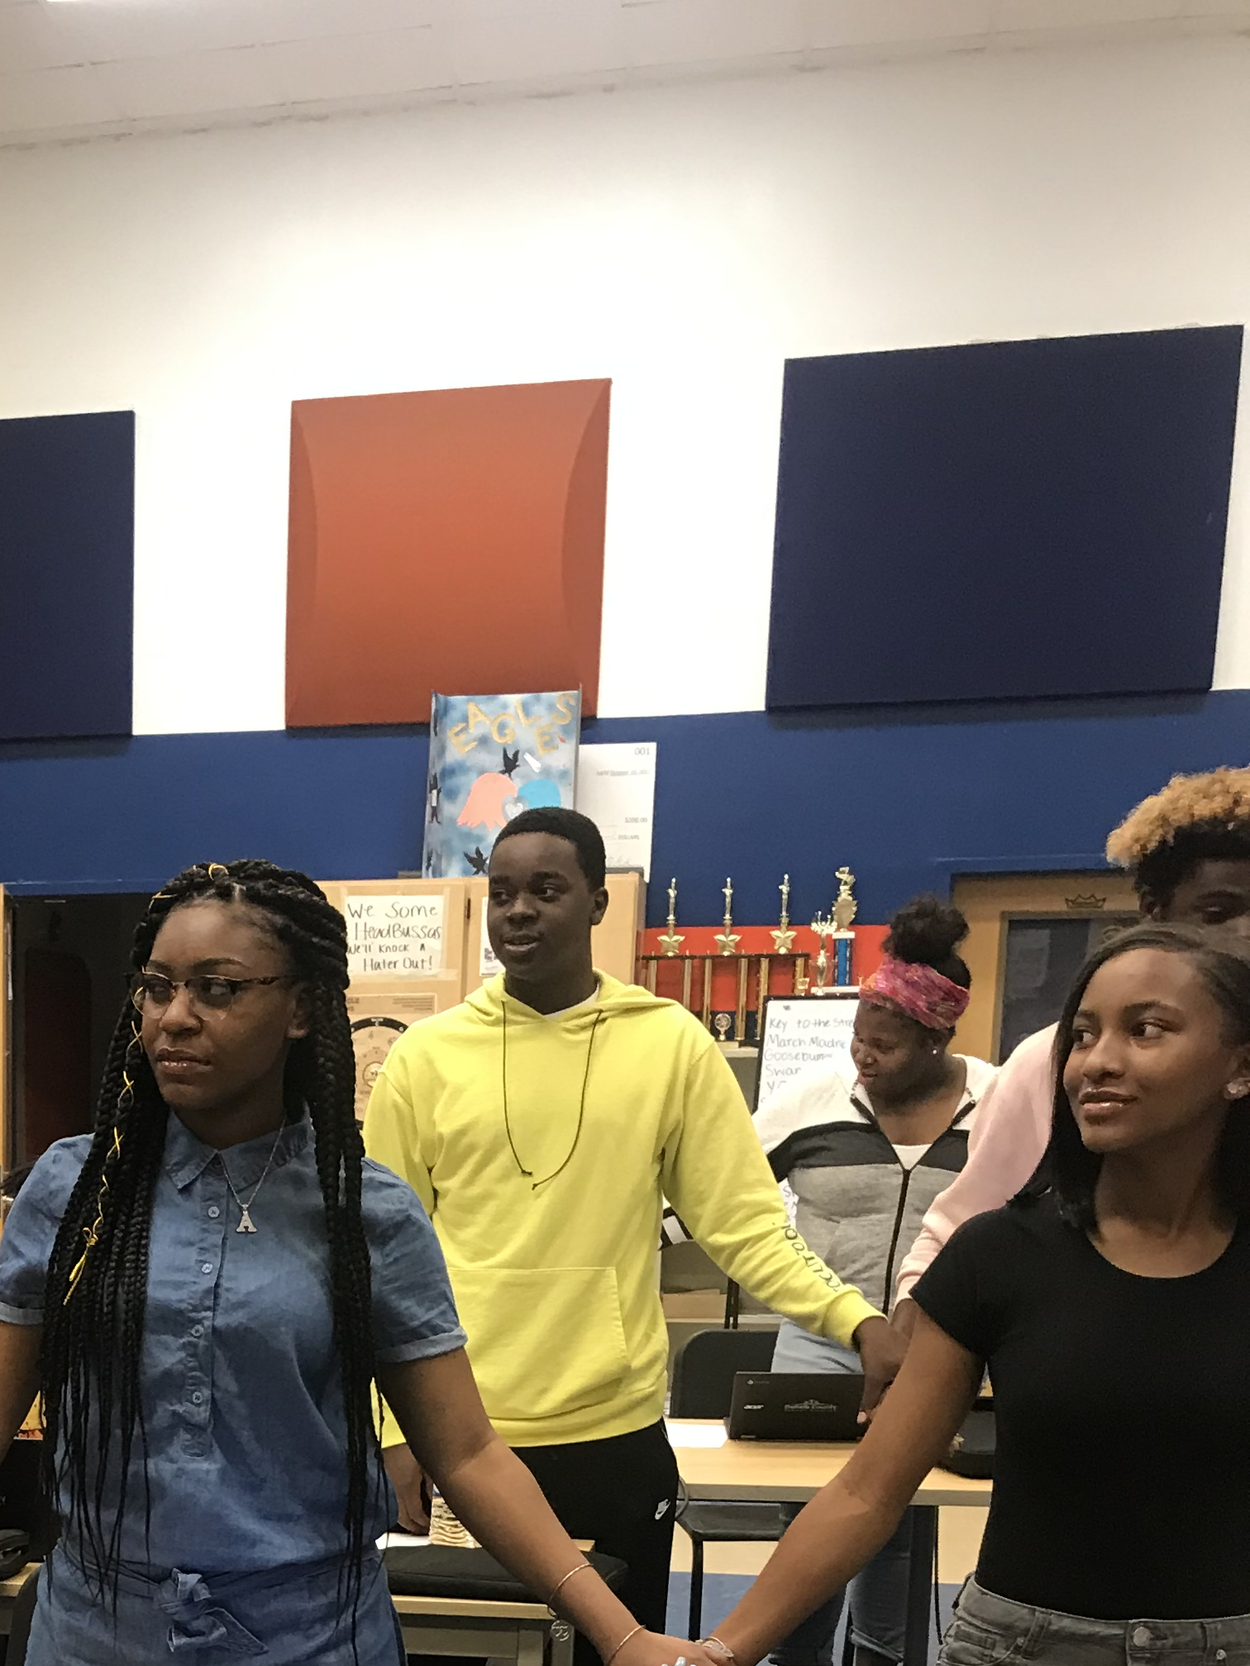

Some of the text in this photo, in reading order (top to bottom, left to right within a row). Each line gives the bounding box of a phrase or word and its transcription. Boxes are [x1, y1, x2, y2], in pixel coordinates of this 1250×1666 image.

[448, 692, 576, 755] EAGLES
[634, 747, 650, 755] 001
[347, 901, 438, 919] We Some
[419, 943, 426, 952] A
[363, 955, 433, 972] Hater Out!
[769, 1017, 788, 1033] Key
[766, 1033, 806, 1049] March
